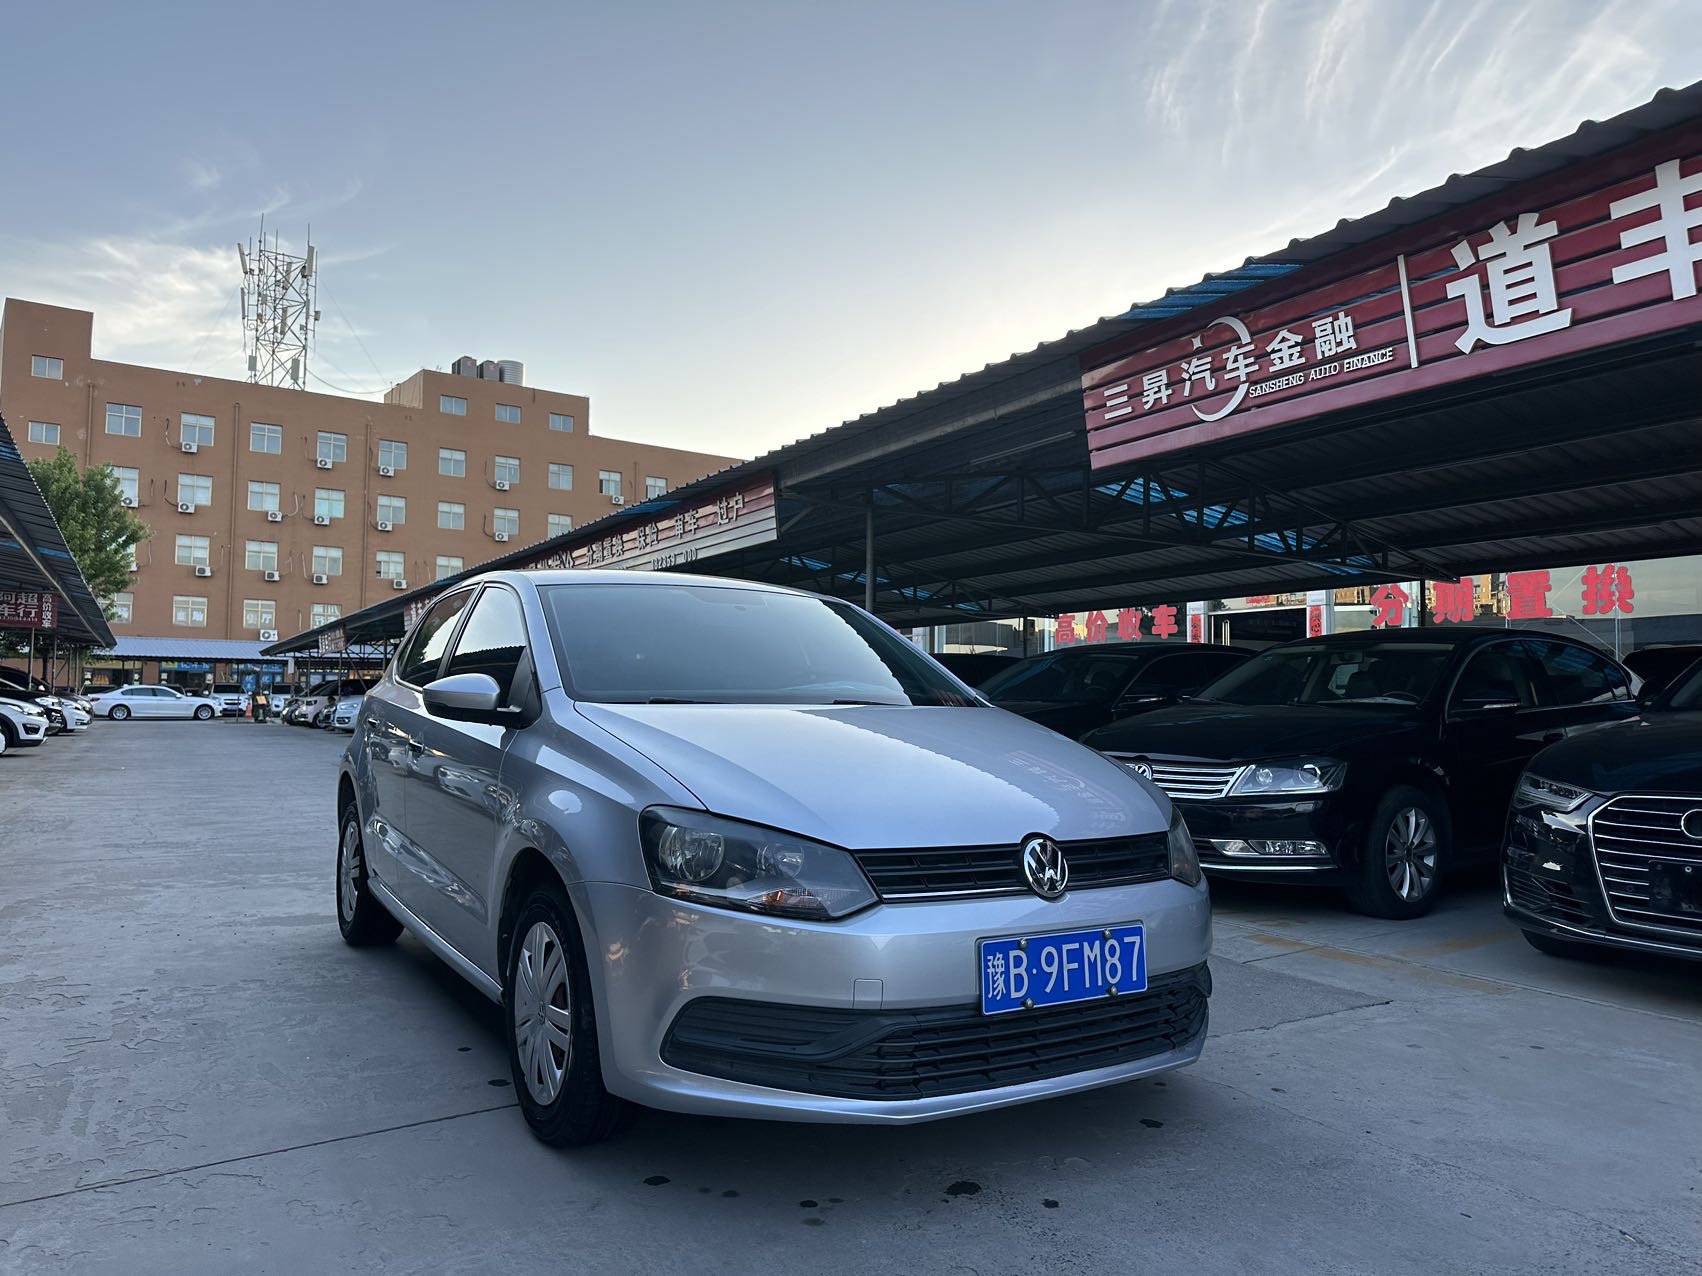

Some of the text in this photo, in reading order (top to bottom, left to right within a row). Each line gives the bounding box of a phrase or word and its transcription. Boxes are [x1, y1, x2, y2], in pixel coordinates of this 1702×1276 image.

[1103, 311, 1358, 420] 三昇汽车金融
[1249, 347, 1394, 398] SANSHENG AUTO FINANCE
[715, 492, 744, 526] 过户
[42, 593, 52, 628] 高价收车
[1370, 563, 1635, 627] 分期置换
[1055, 603, 1179, 645] 高价收车
